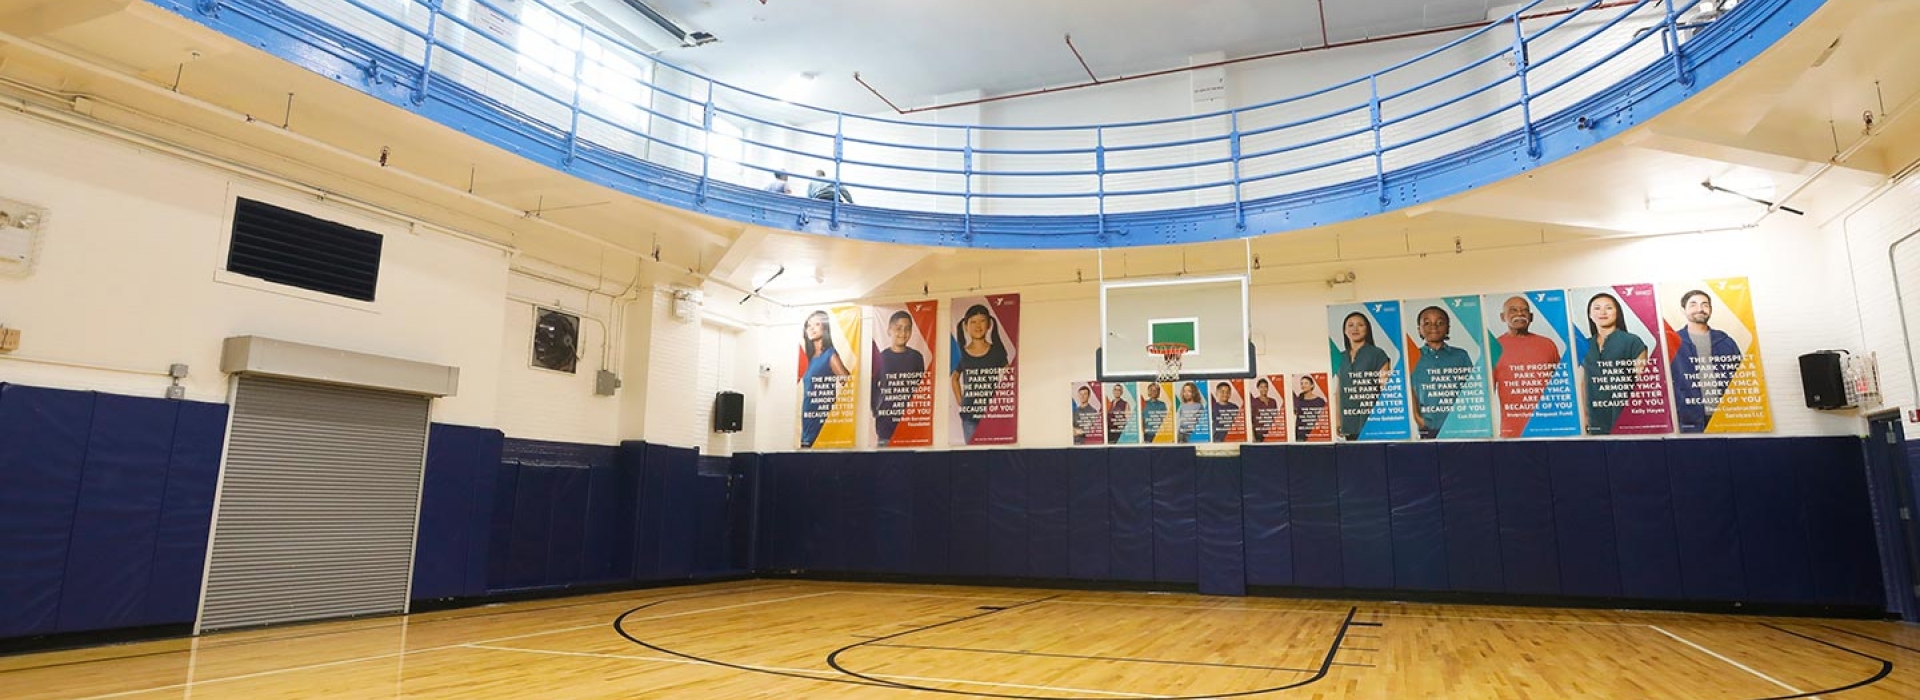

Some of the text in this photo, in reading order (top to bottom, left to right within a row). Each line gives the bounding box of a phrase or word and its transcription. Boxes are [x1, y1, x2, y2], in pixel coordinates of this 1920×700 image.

[1527, 363, 1567, 371] PROSPECT
[1635, 374, 1660, 382] SLOPE
[1511, 387, 1545, 395] ARMORY
[1630, 390, 1662, 398] BETTER
[1645, 398, 1664, 406] YOU
